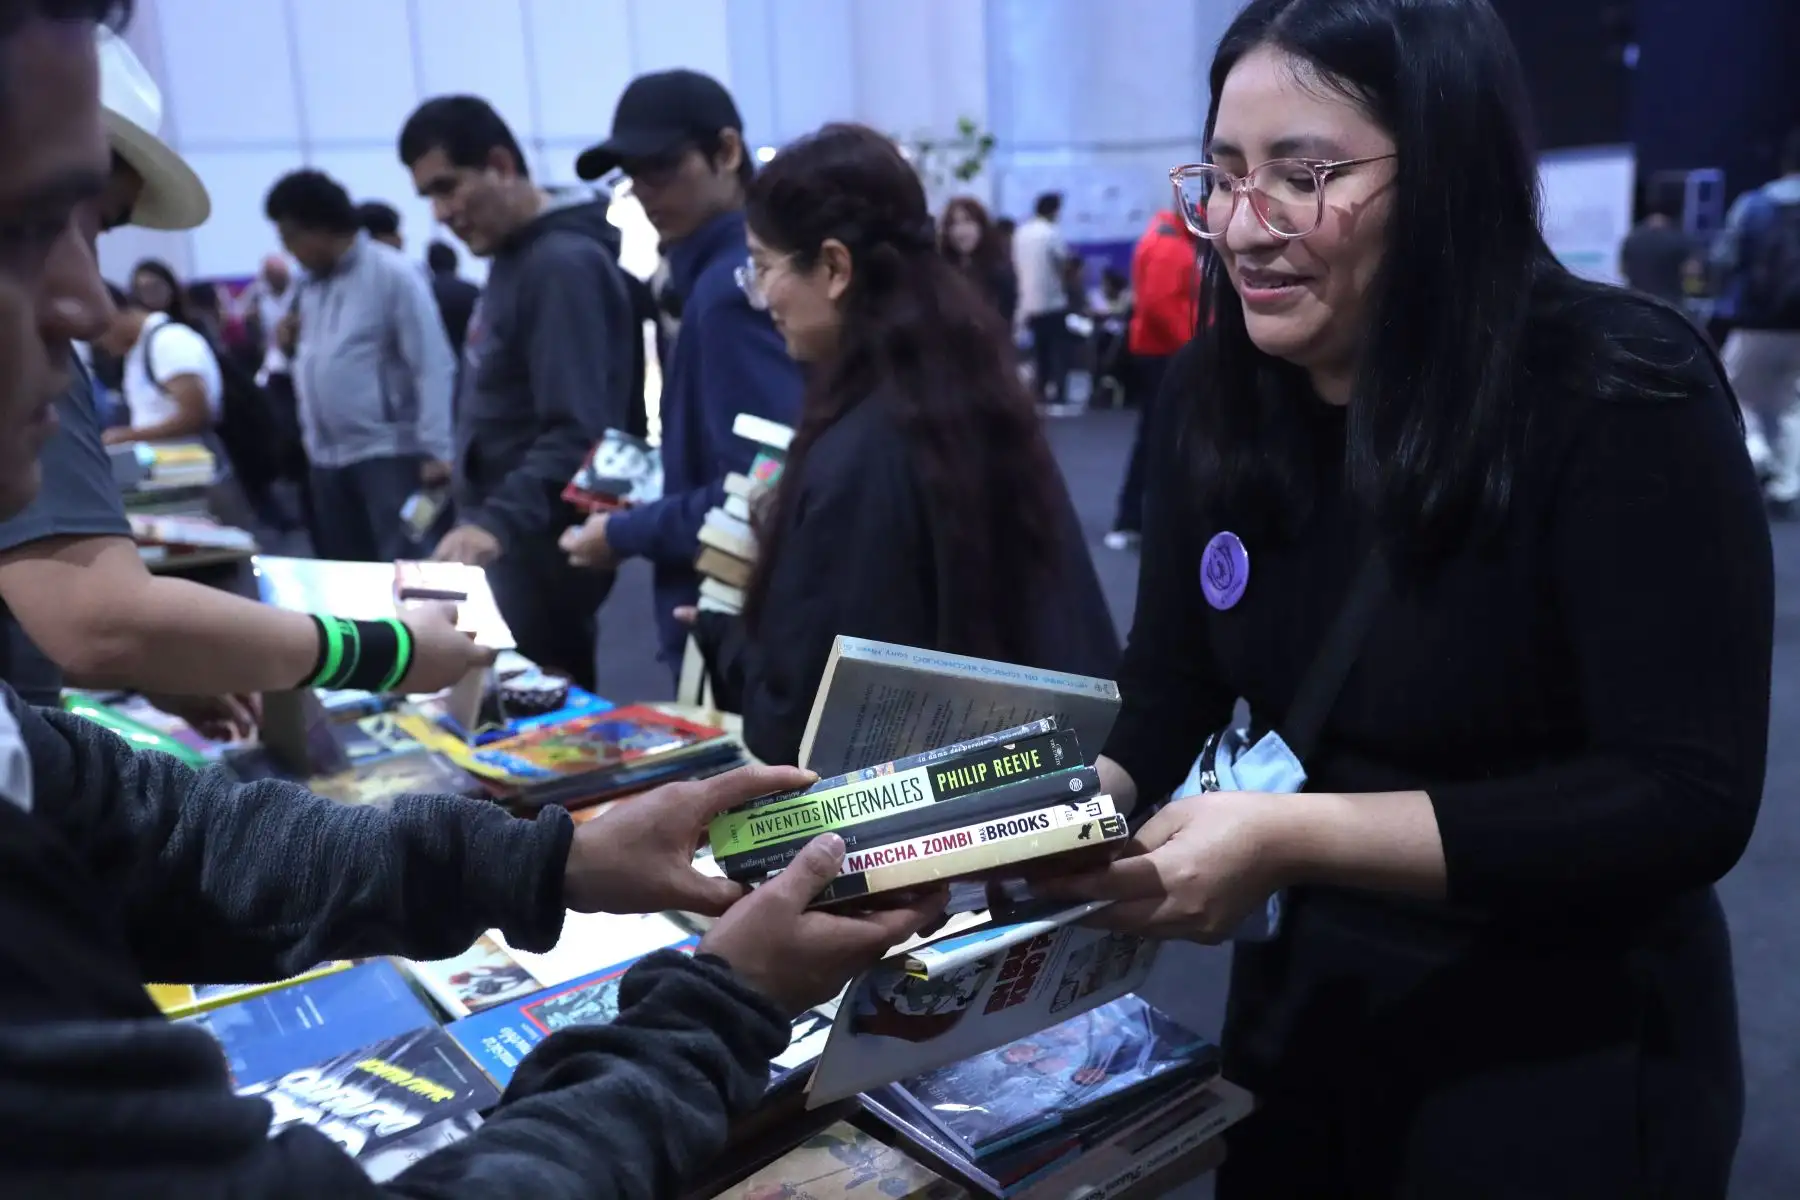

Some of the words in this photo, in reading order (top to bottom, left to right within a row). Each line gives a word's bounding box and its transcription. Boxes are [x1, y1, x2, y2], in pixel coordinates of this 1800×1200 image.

[937, 763, 987, 792] PHILIP
[993, 749, 1042, 778] REEVE
[750, 807, 821, 837] INVENTOS
[821, 777, 924, 825] INFERNALES
[978, 827, 987, 842] MAX
[986, 814, 1050, 840] BROOKS
[848, 844, 917, 872] MARCHA
[922, 831, 973, 856] ZOMBI
